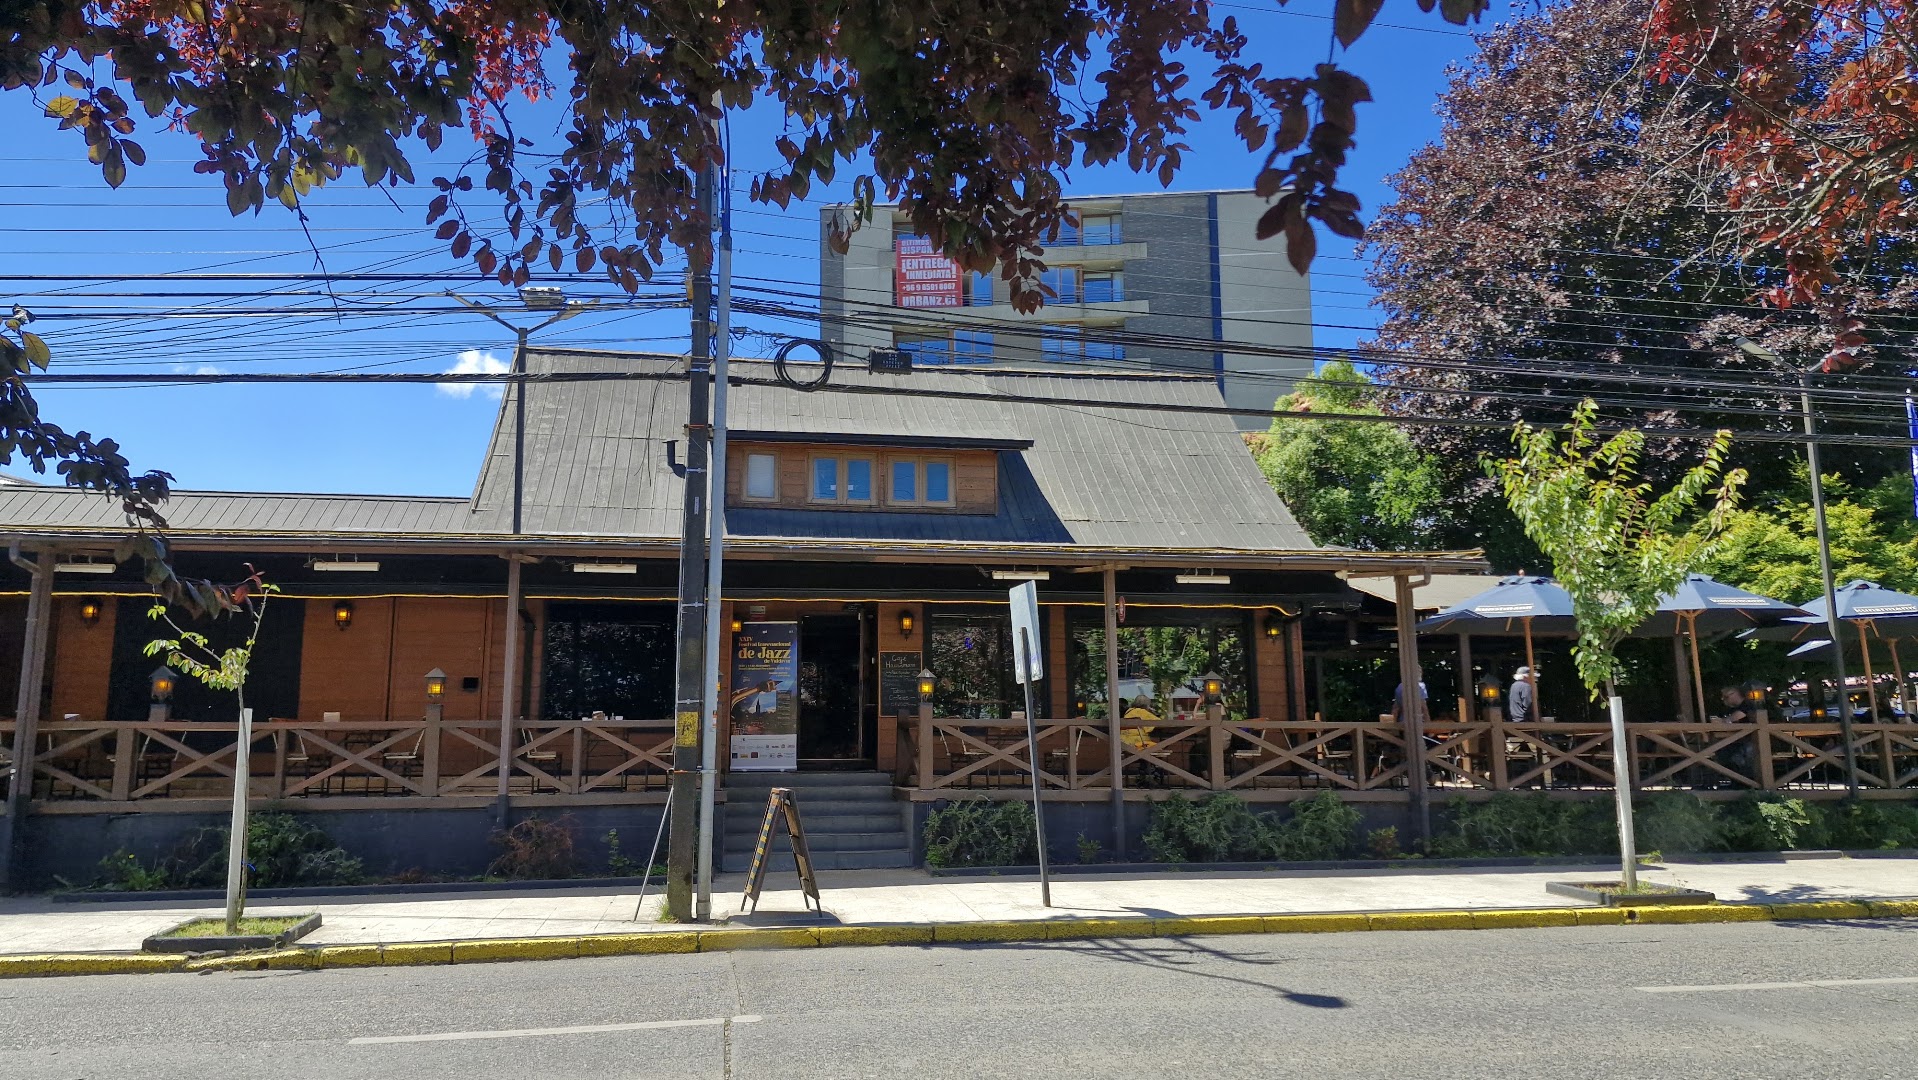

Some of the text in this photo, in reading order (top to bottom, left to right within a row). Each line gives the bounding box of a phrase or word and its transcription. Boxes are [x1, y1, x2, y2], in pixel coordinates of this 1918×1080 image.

[901, 258, 951, 273] ¡ENTREGA
[902, 295, 957, 306] URBANZ.CL
[738, 647, 791, 658] de Jazz
